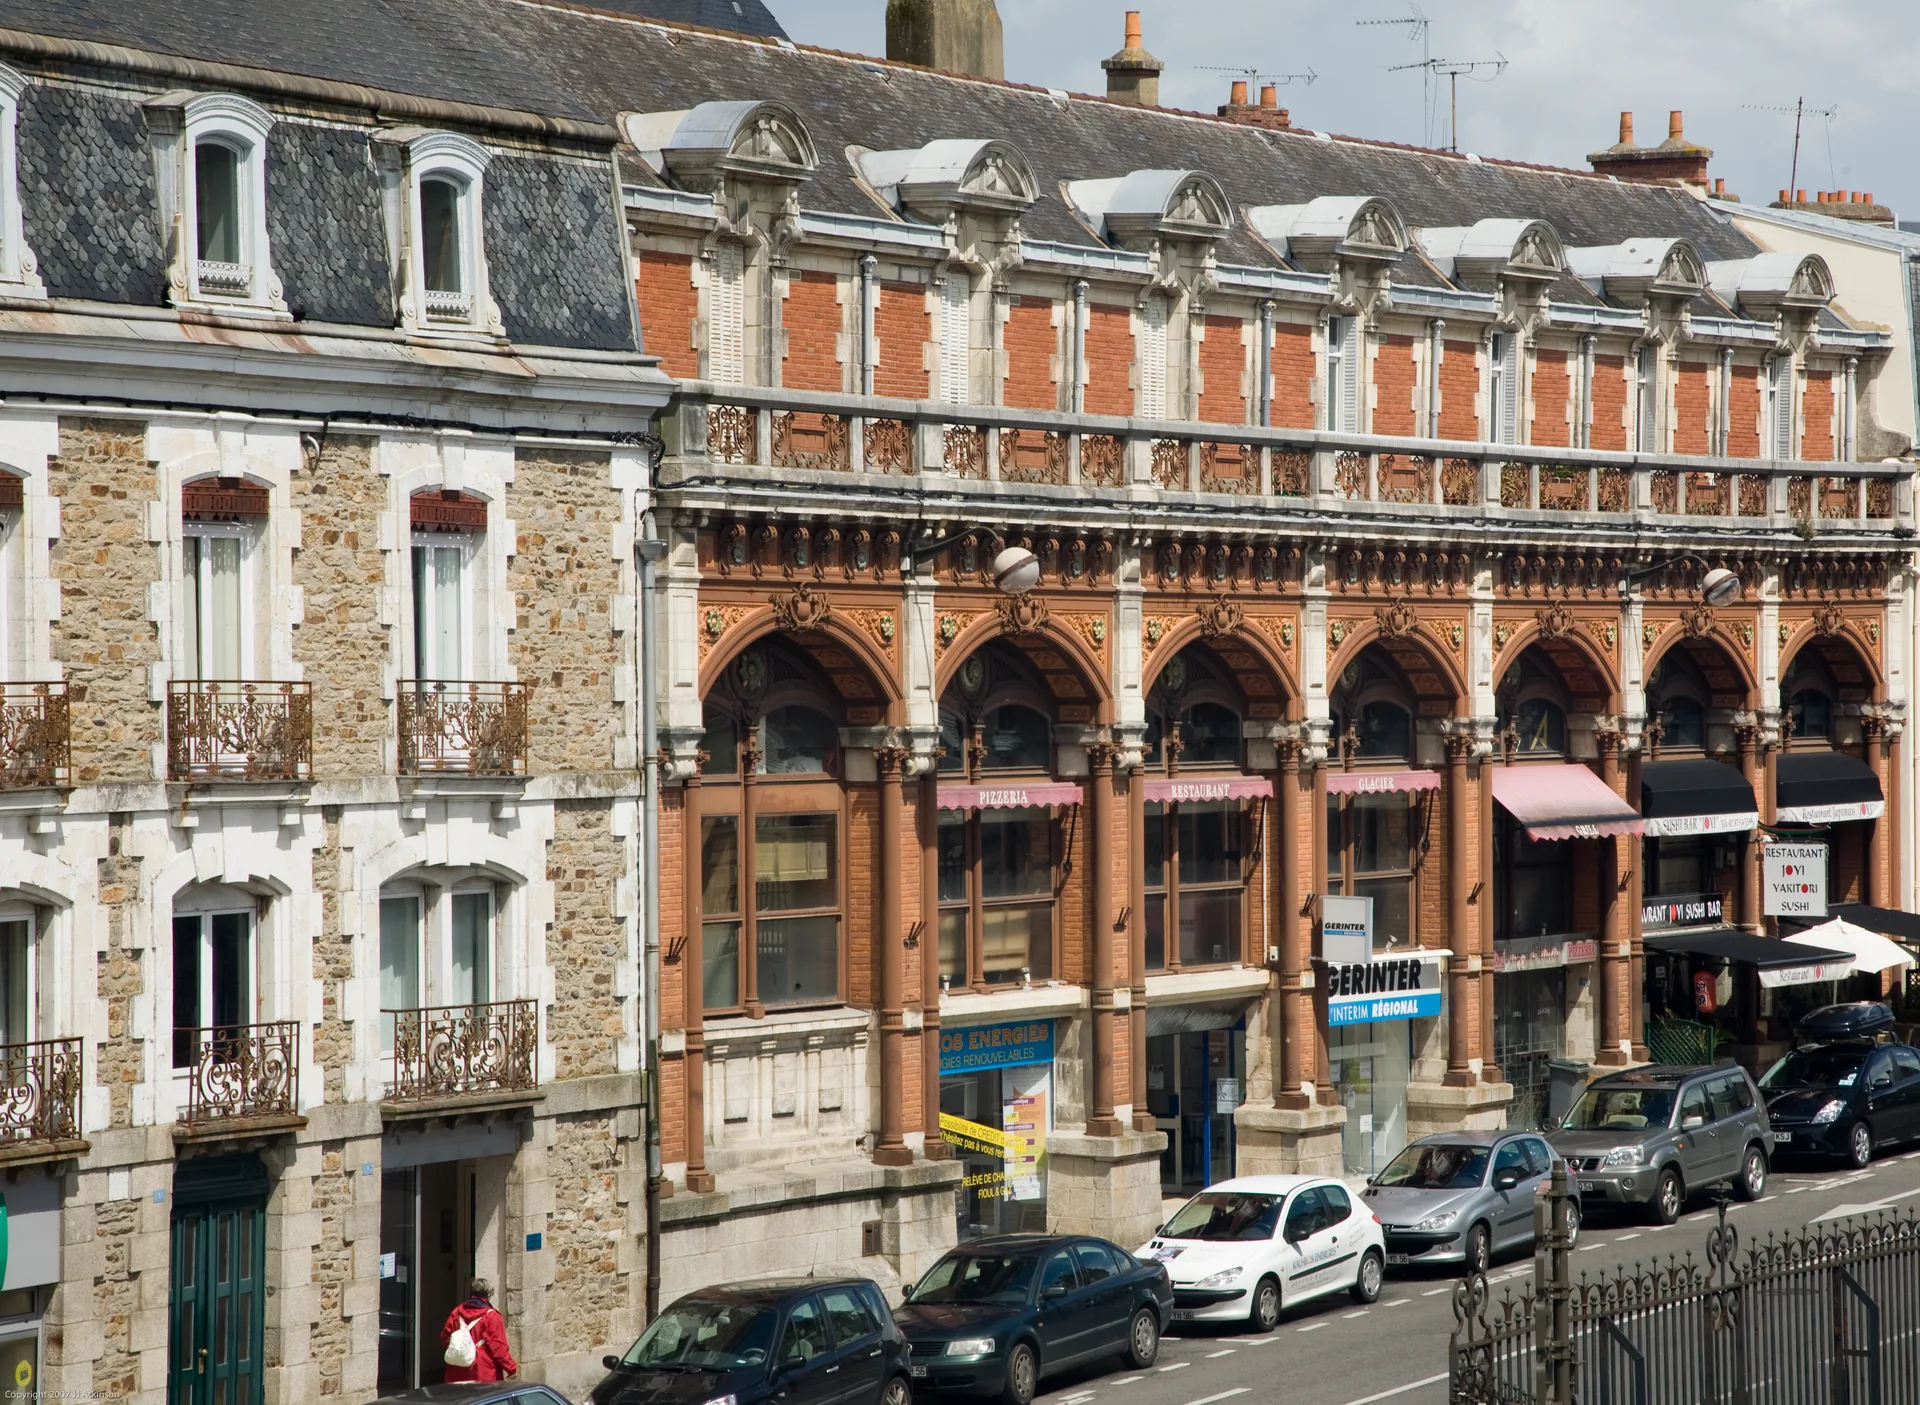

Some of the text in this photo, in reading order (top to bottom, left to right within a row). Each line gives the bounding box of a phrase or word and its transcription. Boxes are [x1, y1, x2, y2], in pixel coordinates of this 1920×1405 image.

[1359, 777, 1394, 790] GLACIER
[979, 790, 1028, 805] PIZZERIA
[1171, 784, 1230, 798] RESTAURANT
[1575, 824, 1600, 836] GRILL
[1663, 819, 1682, 832] SUSHI
[1683, 818, 1698, 830] BAR
[1765, 847, 1824, 858] RESTAURANT
[1782, 864, 1805, 878] JOYI
[1773, 883, 1818, 893] YAKITORI
[1686, 902, 1705, 920] SUSHI
[1707, 900, 1721, 917] BAR
[1781, 901, 1809, 911] SUSHI
[1325, 922, 1365, 931] GERINTER
[1328, 958, 1421, 998] GERINTER
[1329, 999, 1419, 1022] 'INTERIM RÉGIONAL
[940, 1023, 1049, 1053] OS ENERGIES
[963, 1047, 1035, 1067] RENOUVELABLES
[964, 1139, 975, 1150] pas
[980, 1144, 994, 1156] vous
[984, 1172, 992, 1184] DE
